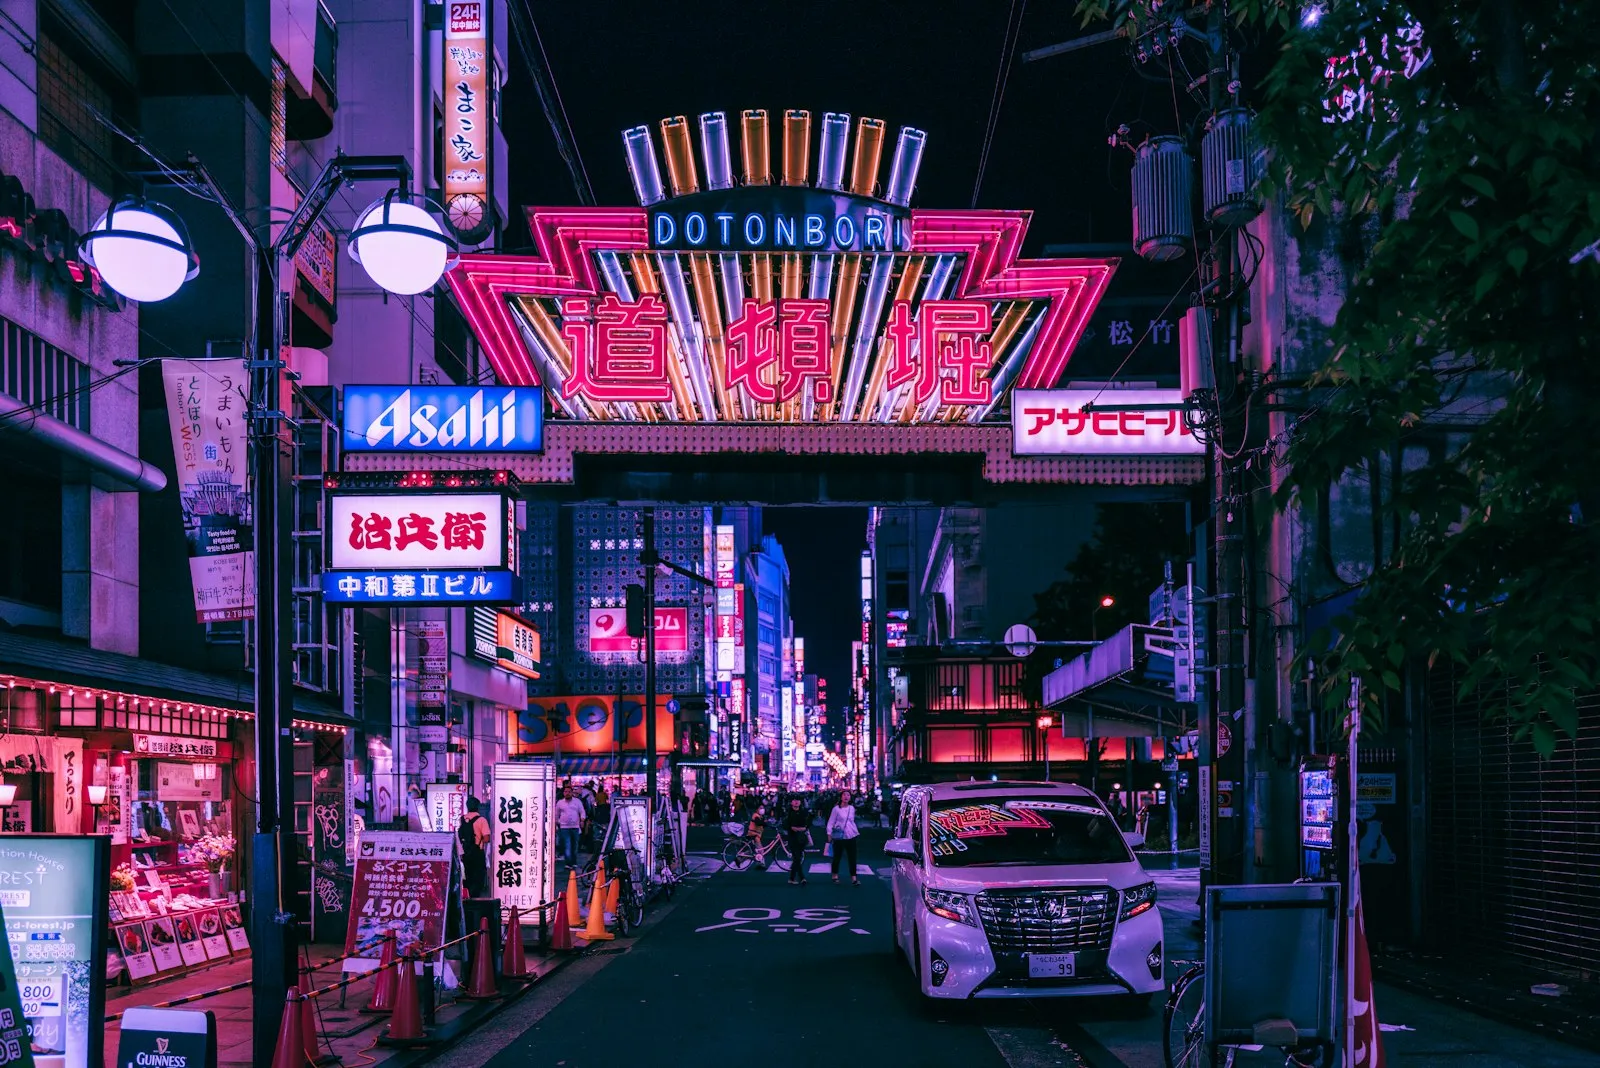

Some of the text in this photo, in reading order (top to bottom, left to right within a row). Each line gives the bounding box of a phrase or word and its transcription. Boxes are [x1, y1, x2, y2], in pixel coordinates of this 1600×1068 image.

[452, 5, 479, 19] 24H
[653, 212, 905, 248] DOTONBORI
[562, 294, 993, 405] 道頓堀
[1108, 319, 1175, 345] 松竹
[366, 389, 515, 447] Asahi
[349, 512, 487, 551] 治兵衛
[496, 796, 524, 888] 治兵衛
[372, 860, 433, 874] ふぐコース
[137, 1052, 186, 1068] GUINNESS
